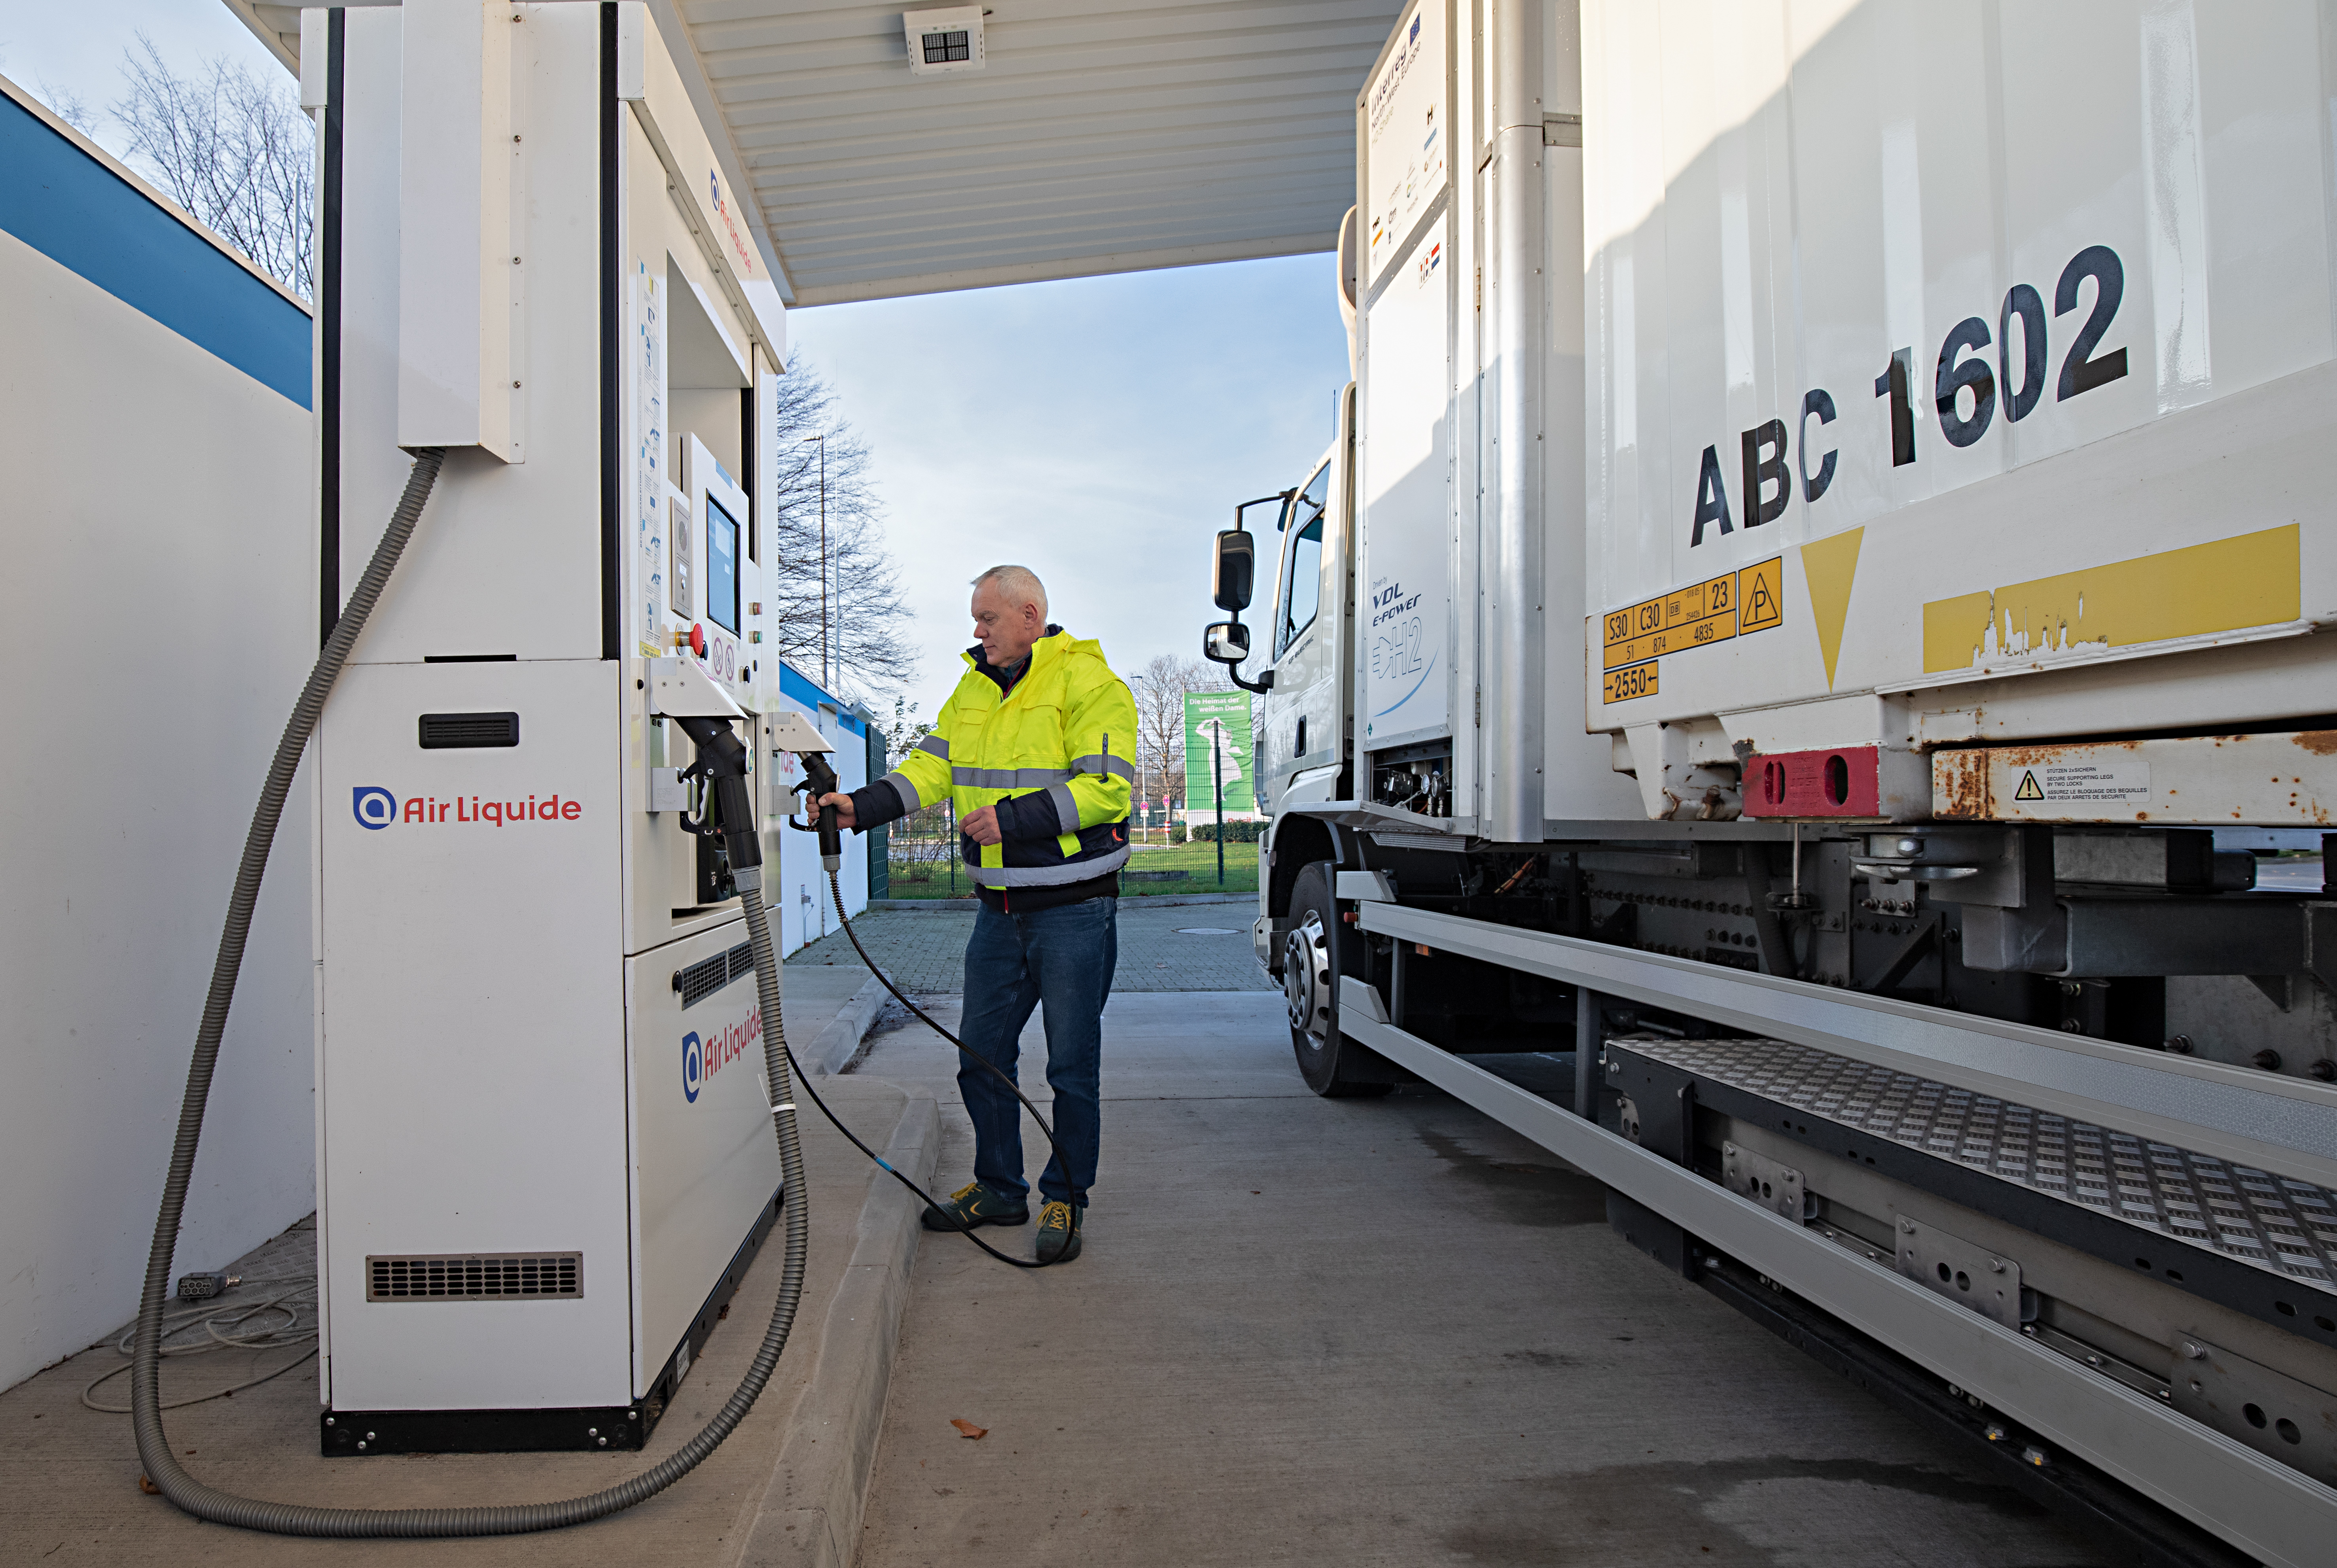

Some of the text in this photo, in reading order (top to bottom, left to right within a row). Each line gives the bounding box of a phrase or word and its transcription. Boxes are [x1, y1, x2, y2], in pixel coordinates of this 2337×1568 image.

[1371, 42, 1406, 116] Interreg
[1372, 76, 1400, 132] North-West
[1401, 41, 1420, 80] Europe
[1372, 106, 1394, 149] H2-Share
[720, 200, 752, 274] Air Liquide
[1690, 245, 2129, 548] ABC 1602
[1373, 576, 1387, 590] Driven by
[1373, 582, 1403, 609] VDL
[1610, 613, 1628, 640] S30
[1640, 603, 1660, 631] C30
[1671, 605, 1679, 614] DB
[1712, 581, 1728, 610] 23
[1687, 610, 1700, 620] 254426
[1627, 622, 1714, 660] 51 874 4835
[1615, 668, 1646, 699] 2550
[404, 794, 581, 827] Air Liquide
[705, 1004, 763, 1082] Air Liquide
